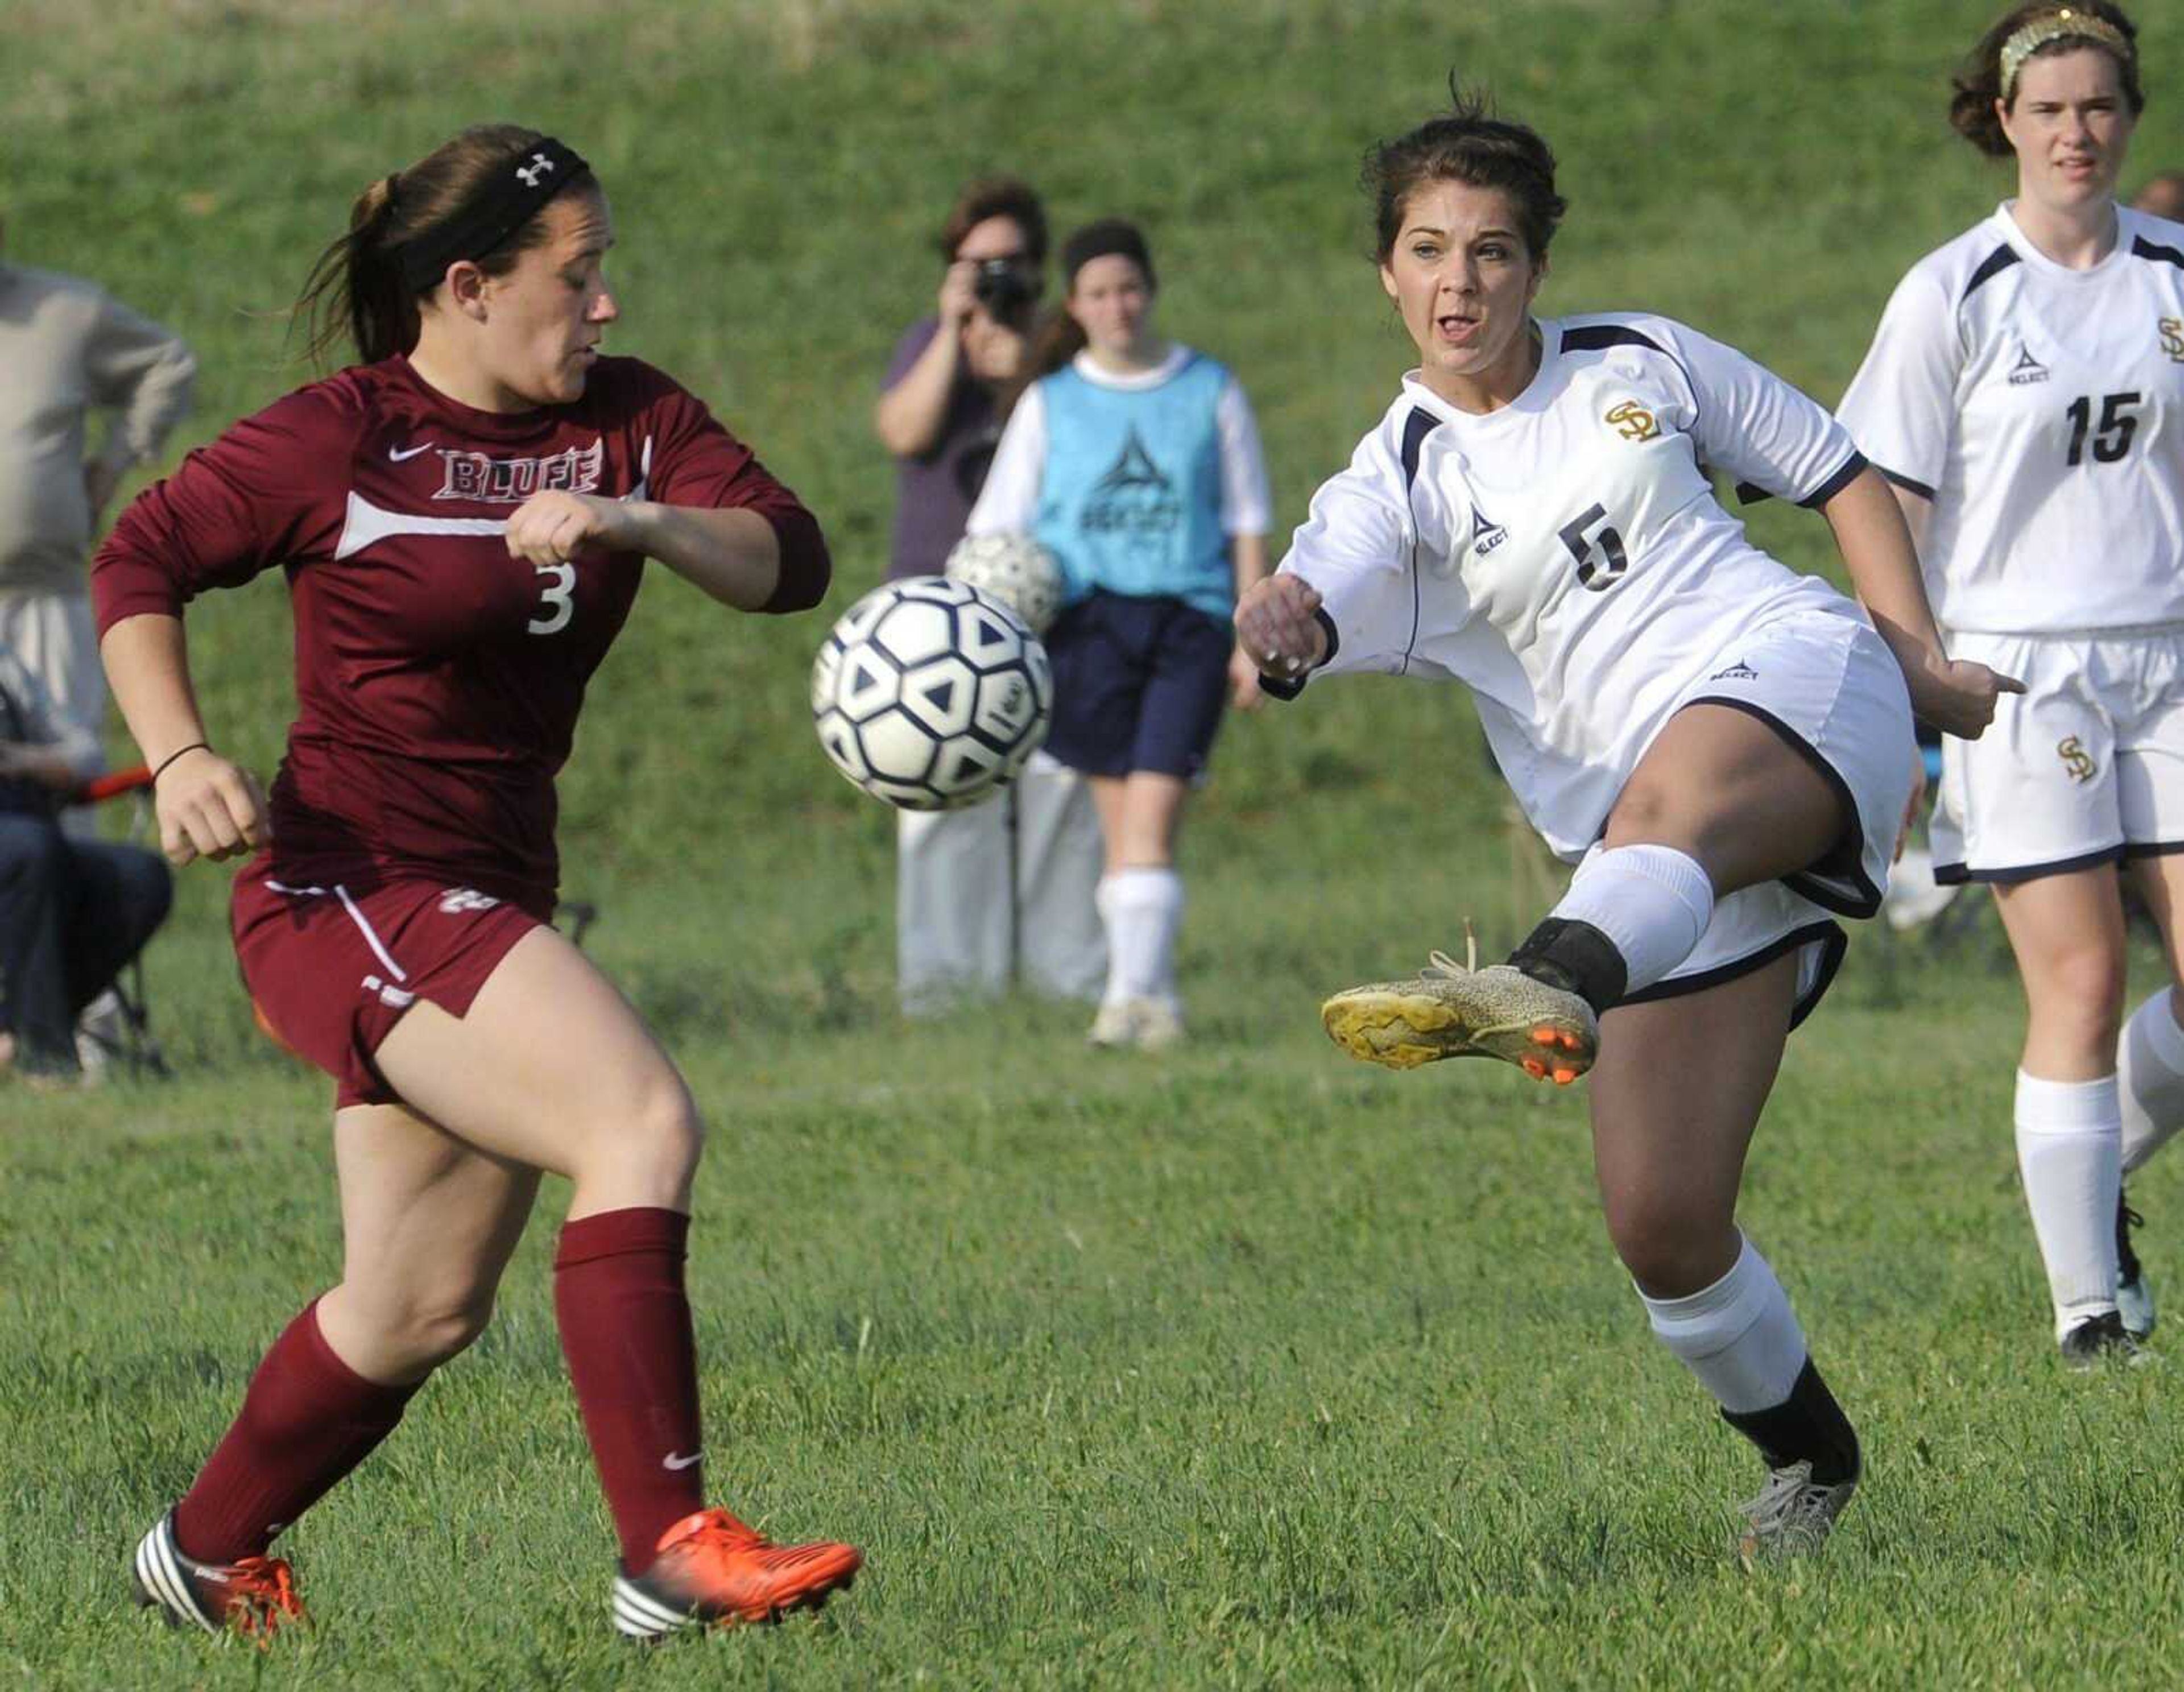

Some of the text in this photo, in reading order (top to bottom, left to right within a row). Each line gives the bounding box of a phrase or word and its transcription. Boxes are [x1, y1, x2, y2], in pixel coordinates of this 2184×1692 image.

[2066, 391, 2141, 467] 15
[431, 436, 603, 503] BLUFF
[1558, 502, 1628, 592] 5
[528, 562, 576, 635] 3
